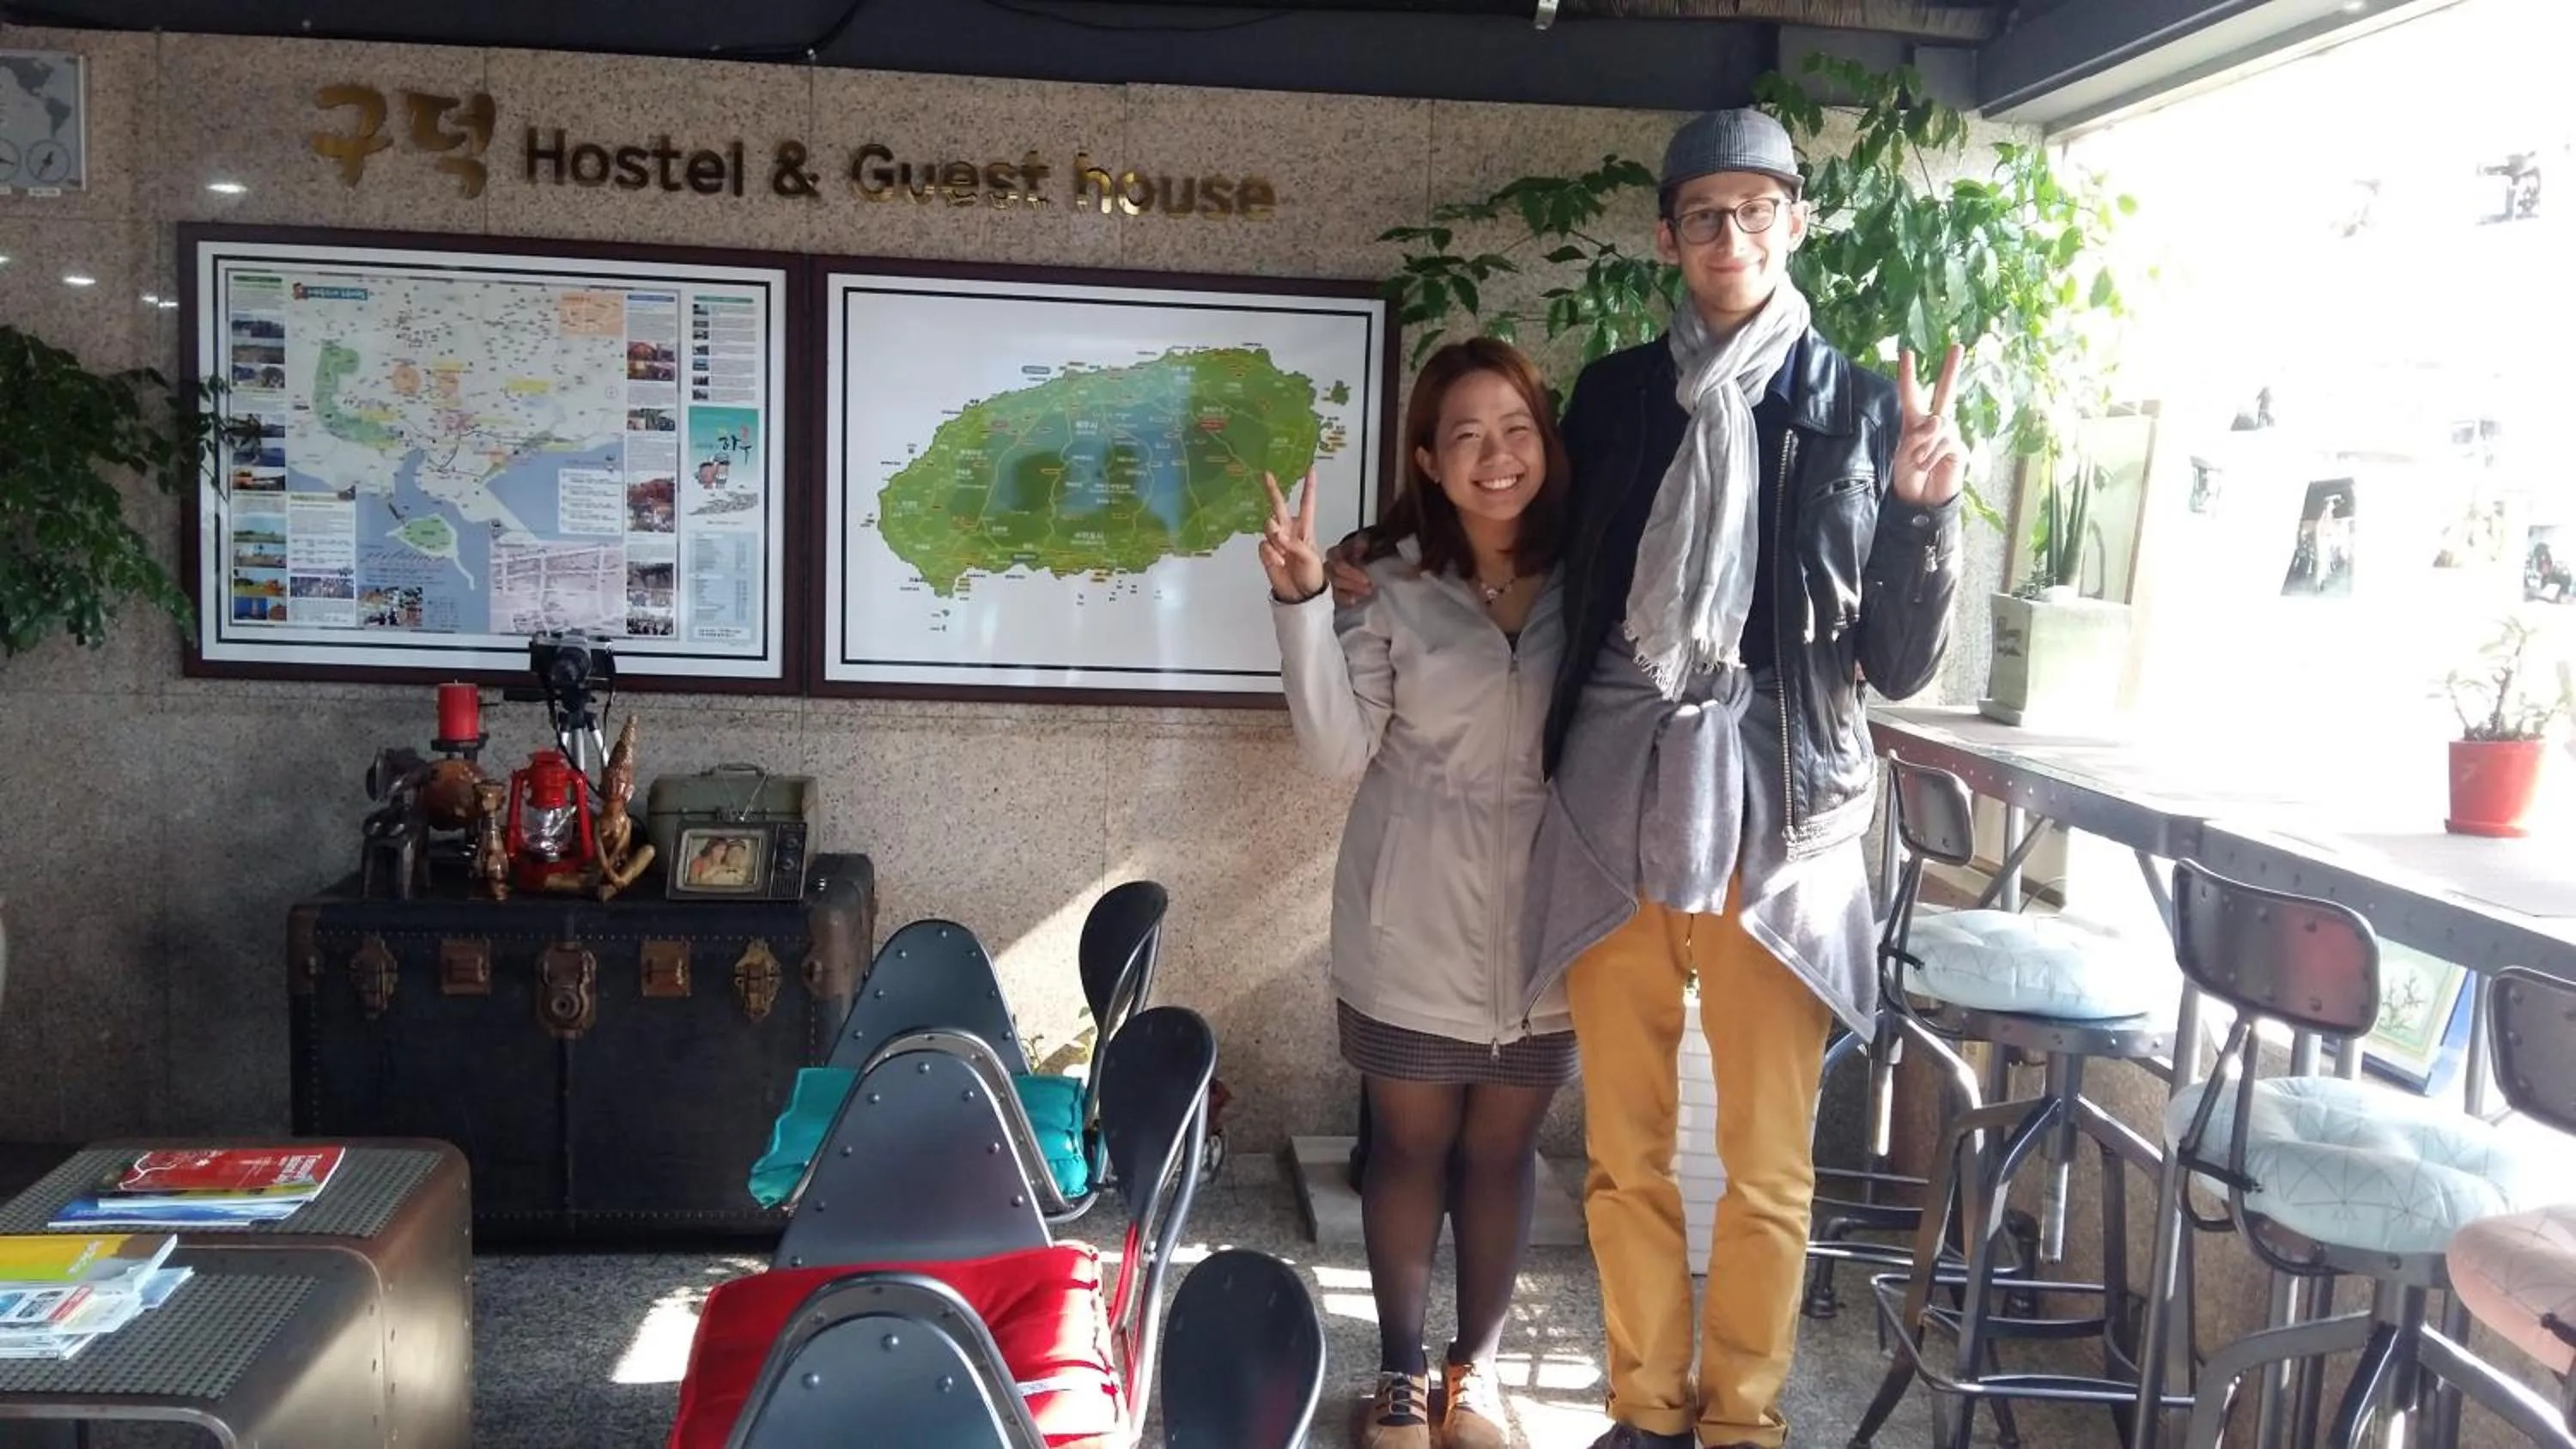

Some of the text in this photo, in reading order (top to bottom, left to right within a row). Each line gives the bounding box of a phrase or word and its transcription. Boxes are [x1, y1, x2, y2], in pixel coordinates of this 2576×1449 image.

[312, 84, 1277, 220] 구덕 Hostel & Guest house
